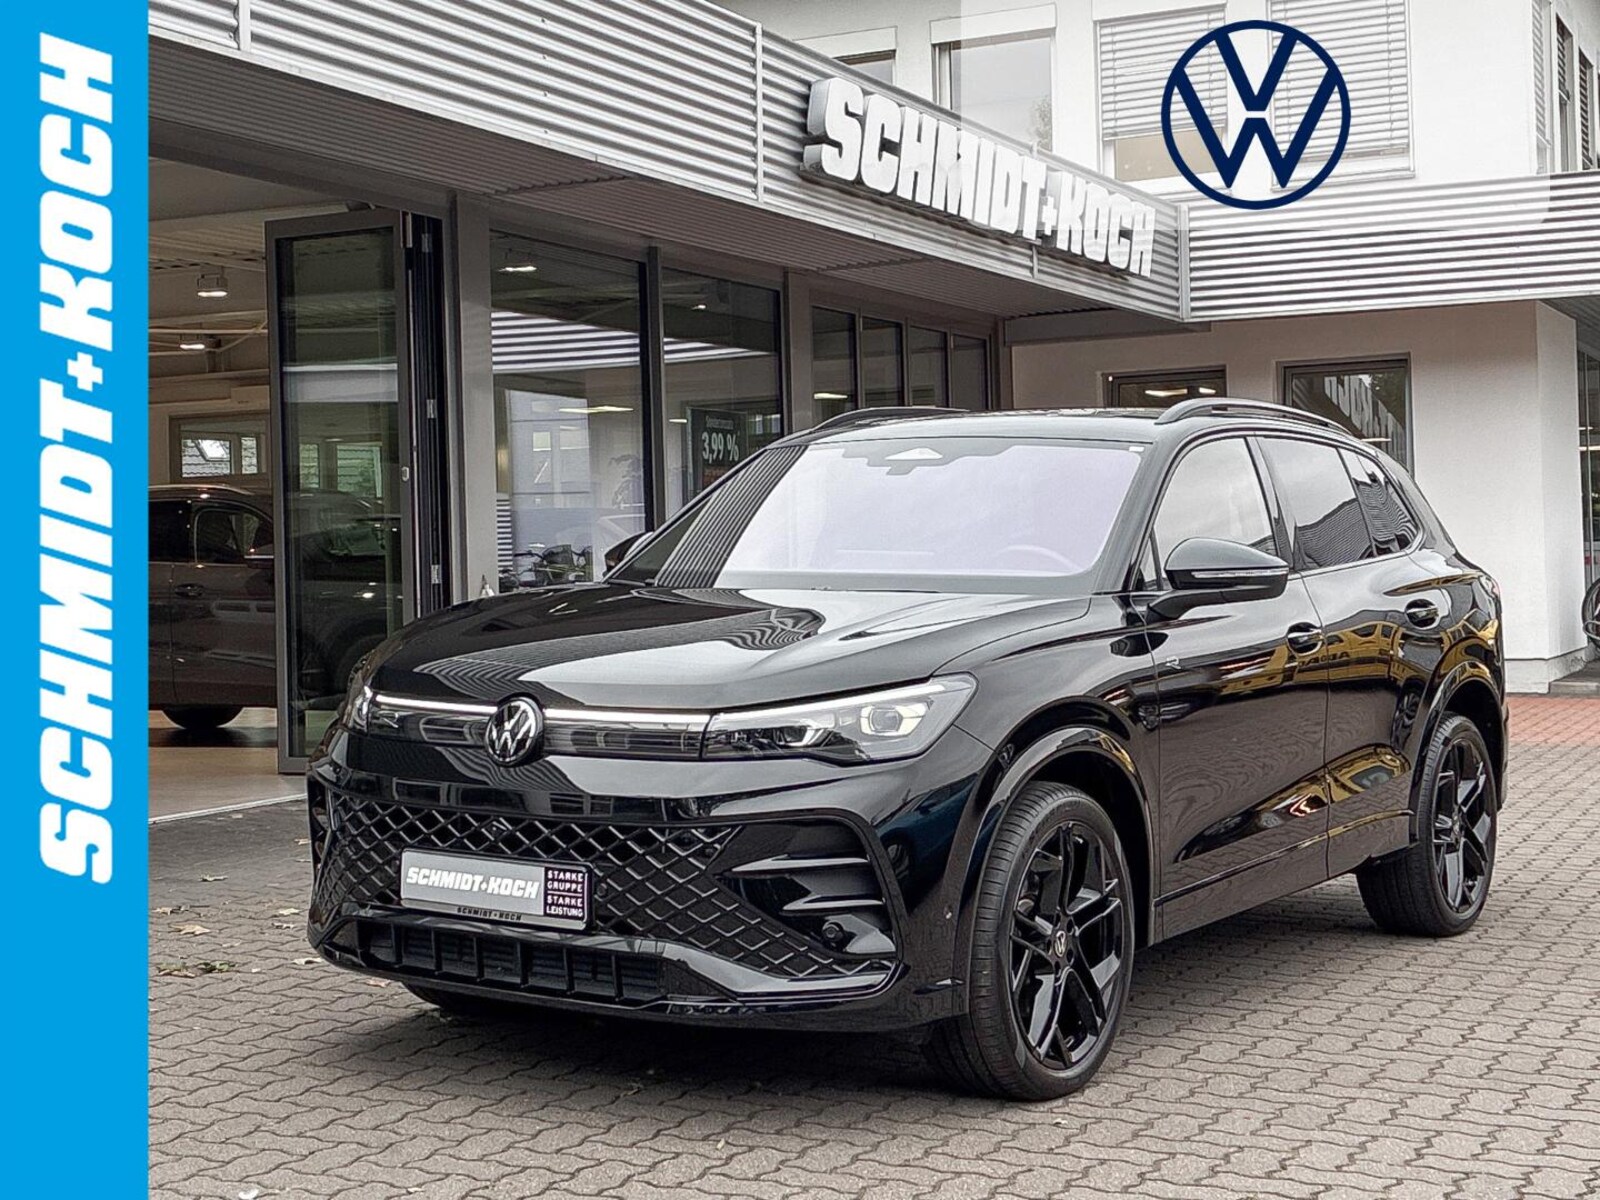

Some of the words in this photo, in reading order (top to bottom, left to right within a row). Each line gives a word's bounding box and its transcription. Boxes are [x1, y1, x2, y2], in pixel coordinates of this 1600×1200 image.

[804, 77, 1156, 278] SCHMIDT+KOCH
[702, 431, 724, 464] 3,99
[547, 870, 584, 882] STARKE
[406, 867, 540, 899] SCHMIDT+KOCH
[547, 880, 583, 893] GRUPPE
[547, 894, 583, 907] STARKE
[546, 905, 584, 917] LEISTUNG
